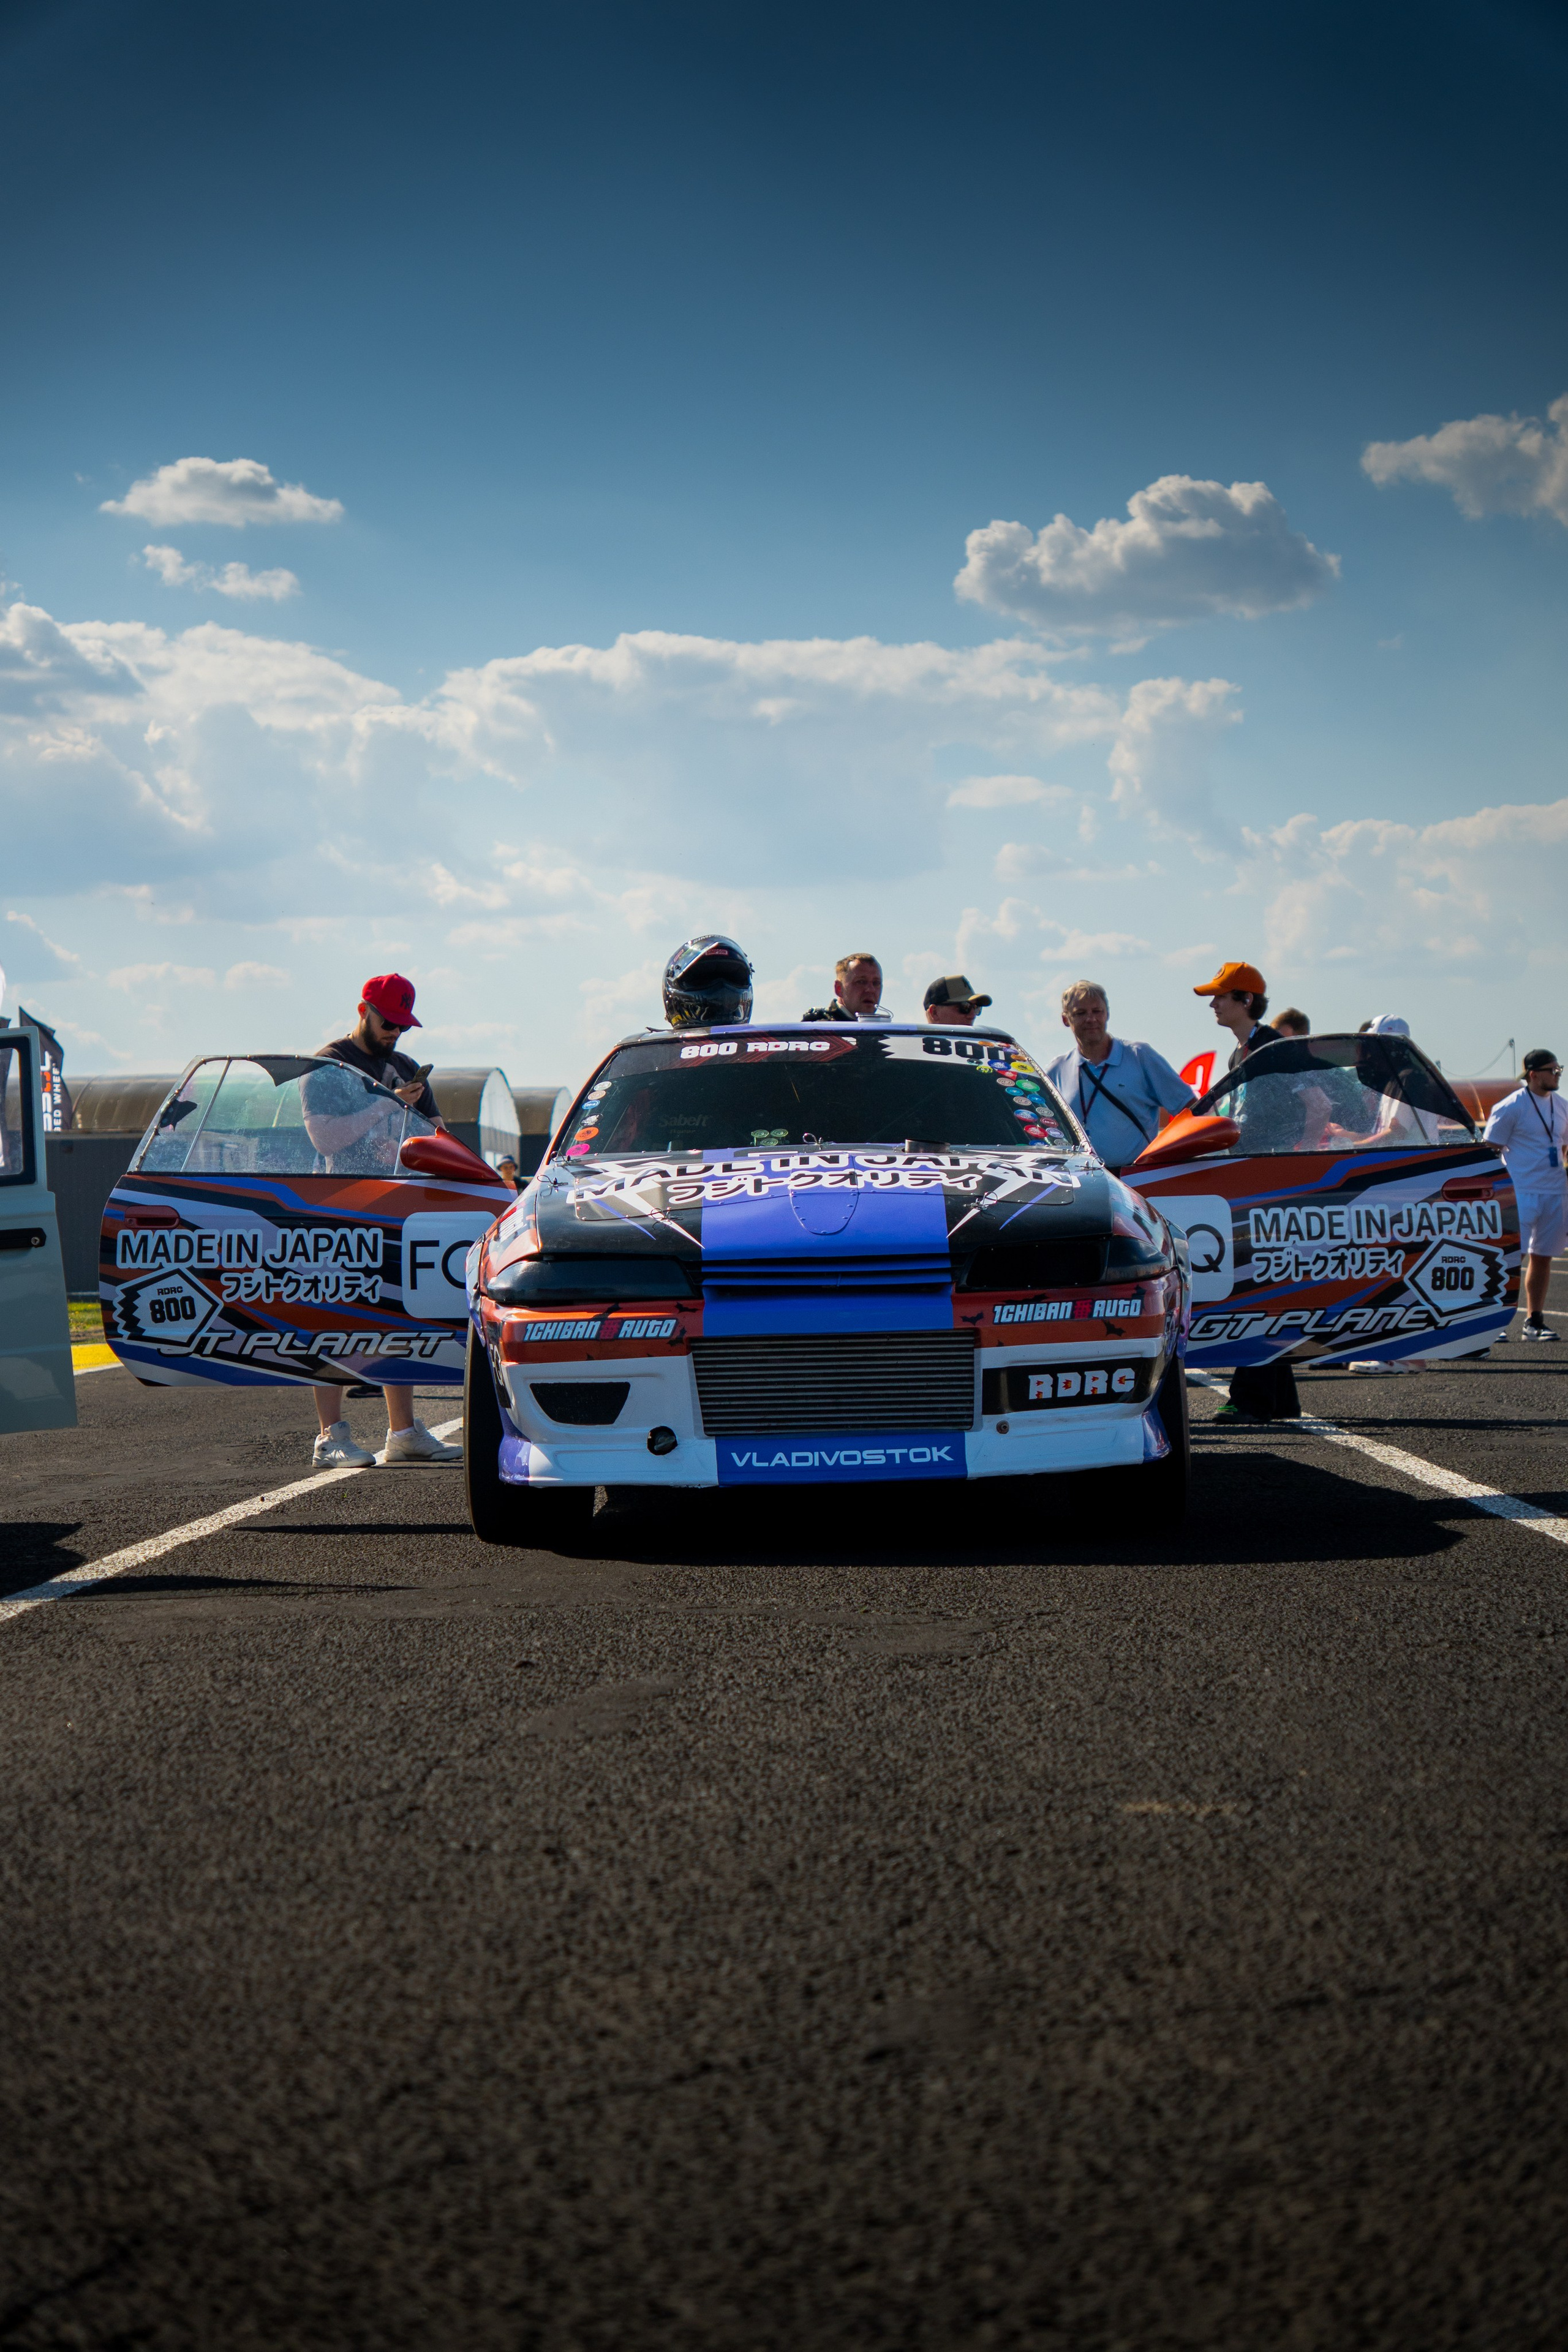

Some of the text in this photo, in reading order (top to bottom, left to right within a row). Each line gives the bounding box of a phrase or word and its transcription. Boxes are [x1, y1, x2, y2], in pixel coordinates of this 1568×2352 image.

[680, 1042, 737, 1059] 800
[1253, 1205, 1499, 1243] MADE IN JAPAN
[121, 1232, 379, 1264] MADE IN JAPAN
[1254, 1250, 1403, 1278] フジトクオリティ
[156, 1286, 183, 1296] RDRC
[1431, 1267, 1474, 1291] 800
[148, 1295, 197, 1324] 800
[1093, 1298, 1142, 1317] AUTO
[618, 1319, 676, 1338] AUTO
[1191, 1313, 1265, 1338] GT
[241, 1332, 454, 1355] PLANET
[1028, 1367, 1136, 1400] RDRC
[731, 1446, 955, 1468] VLADIVOSTOK
